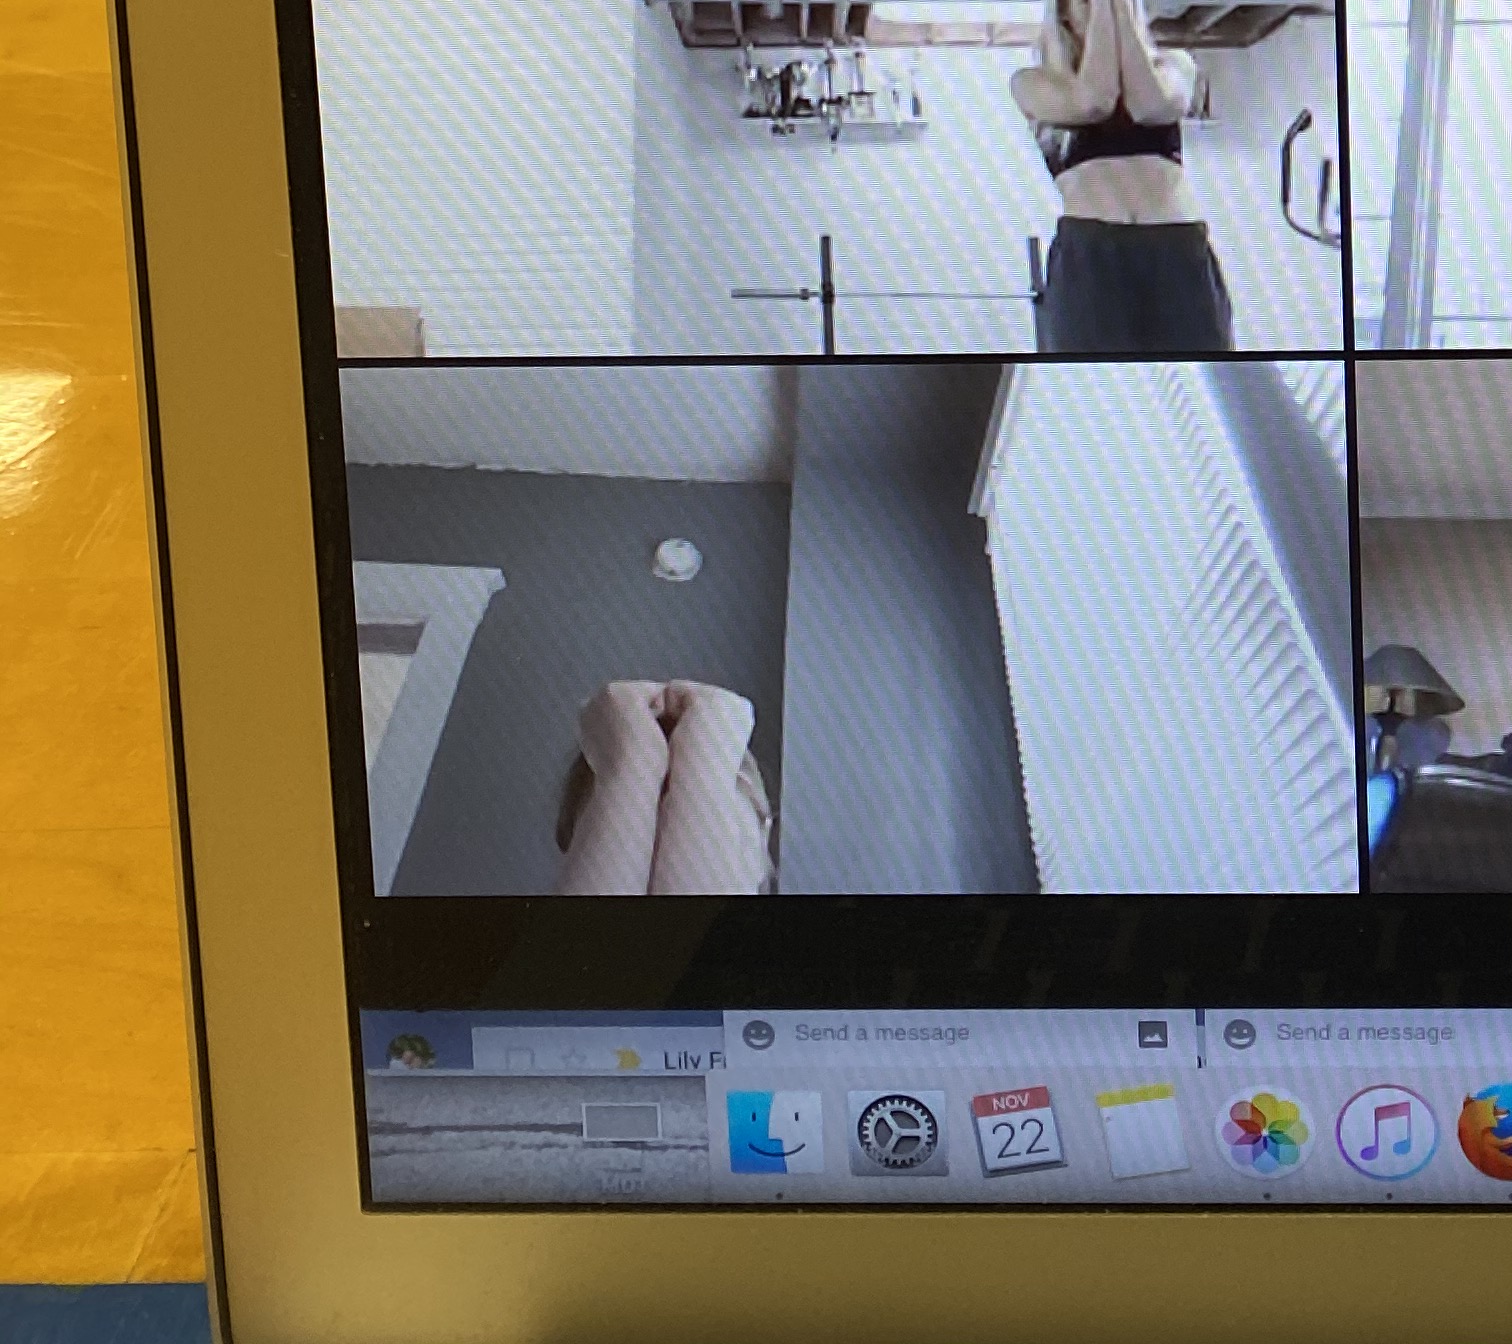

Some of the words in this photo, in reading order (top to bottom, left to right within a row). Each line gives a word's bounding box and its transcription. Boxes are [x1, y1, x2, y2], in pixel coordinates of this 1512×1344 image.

[795, 1023, 849, 1042] Send
[855, 1027, 869, 1041] a
[875, 1026, 970, 1046] message
[1276, 1022, 1332, 1041] Send
[1337, 1027, 1350, 1041] a
[1356, 1025, 1453, 1046] message
[709, 1051, 727, 1070] F
[992, 1092, 1030, 1111] NOV
[992, 1118, 1050, 1159] 22
